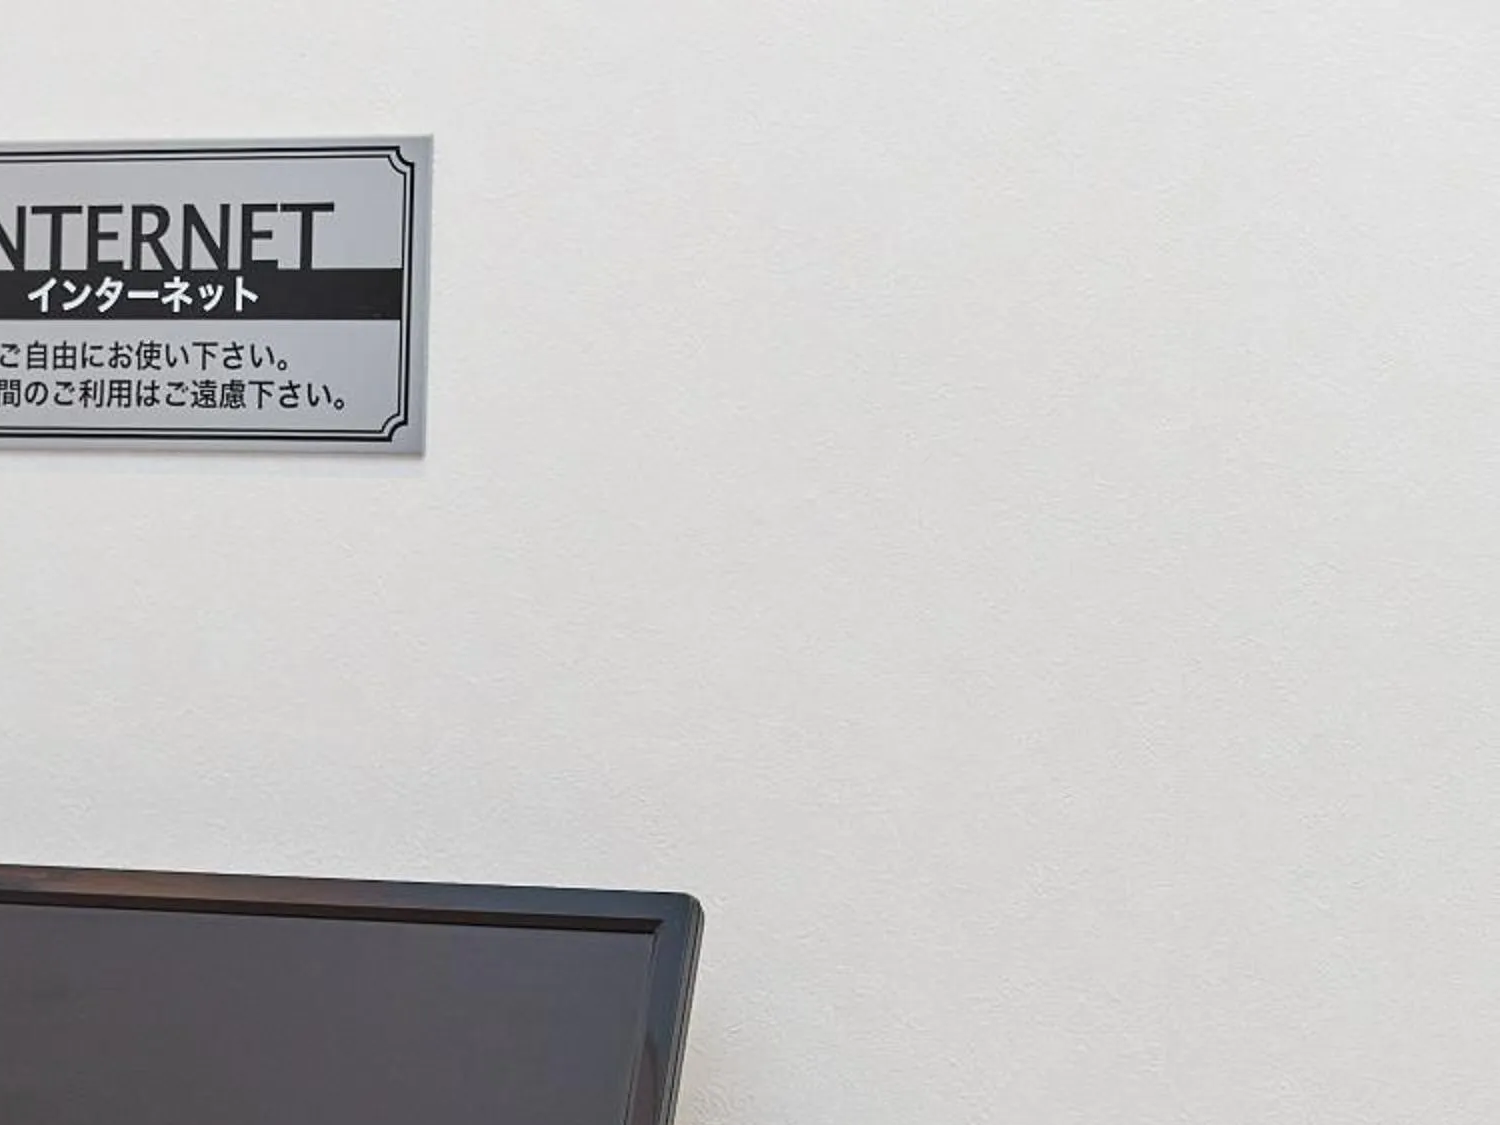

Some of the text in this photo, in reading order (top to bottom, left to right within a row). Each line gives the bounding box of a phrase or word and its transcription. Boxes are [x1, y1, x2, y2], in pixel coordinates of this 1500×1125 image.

[27, 275, 260, 313] インターネット
